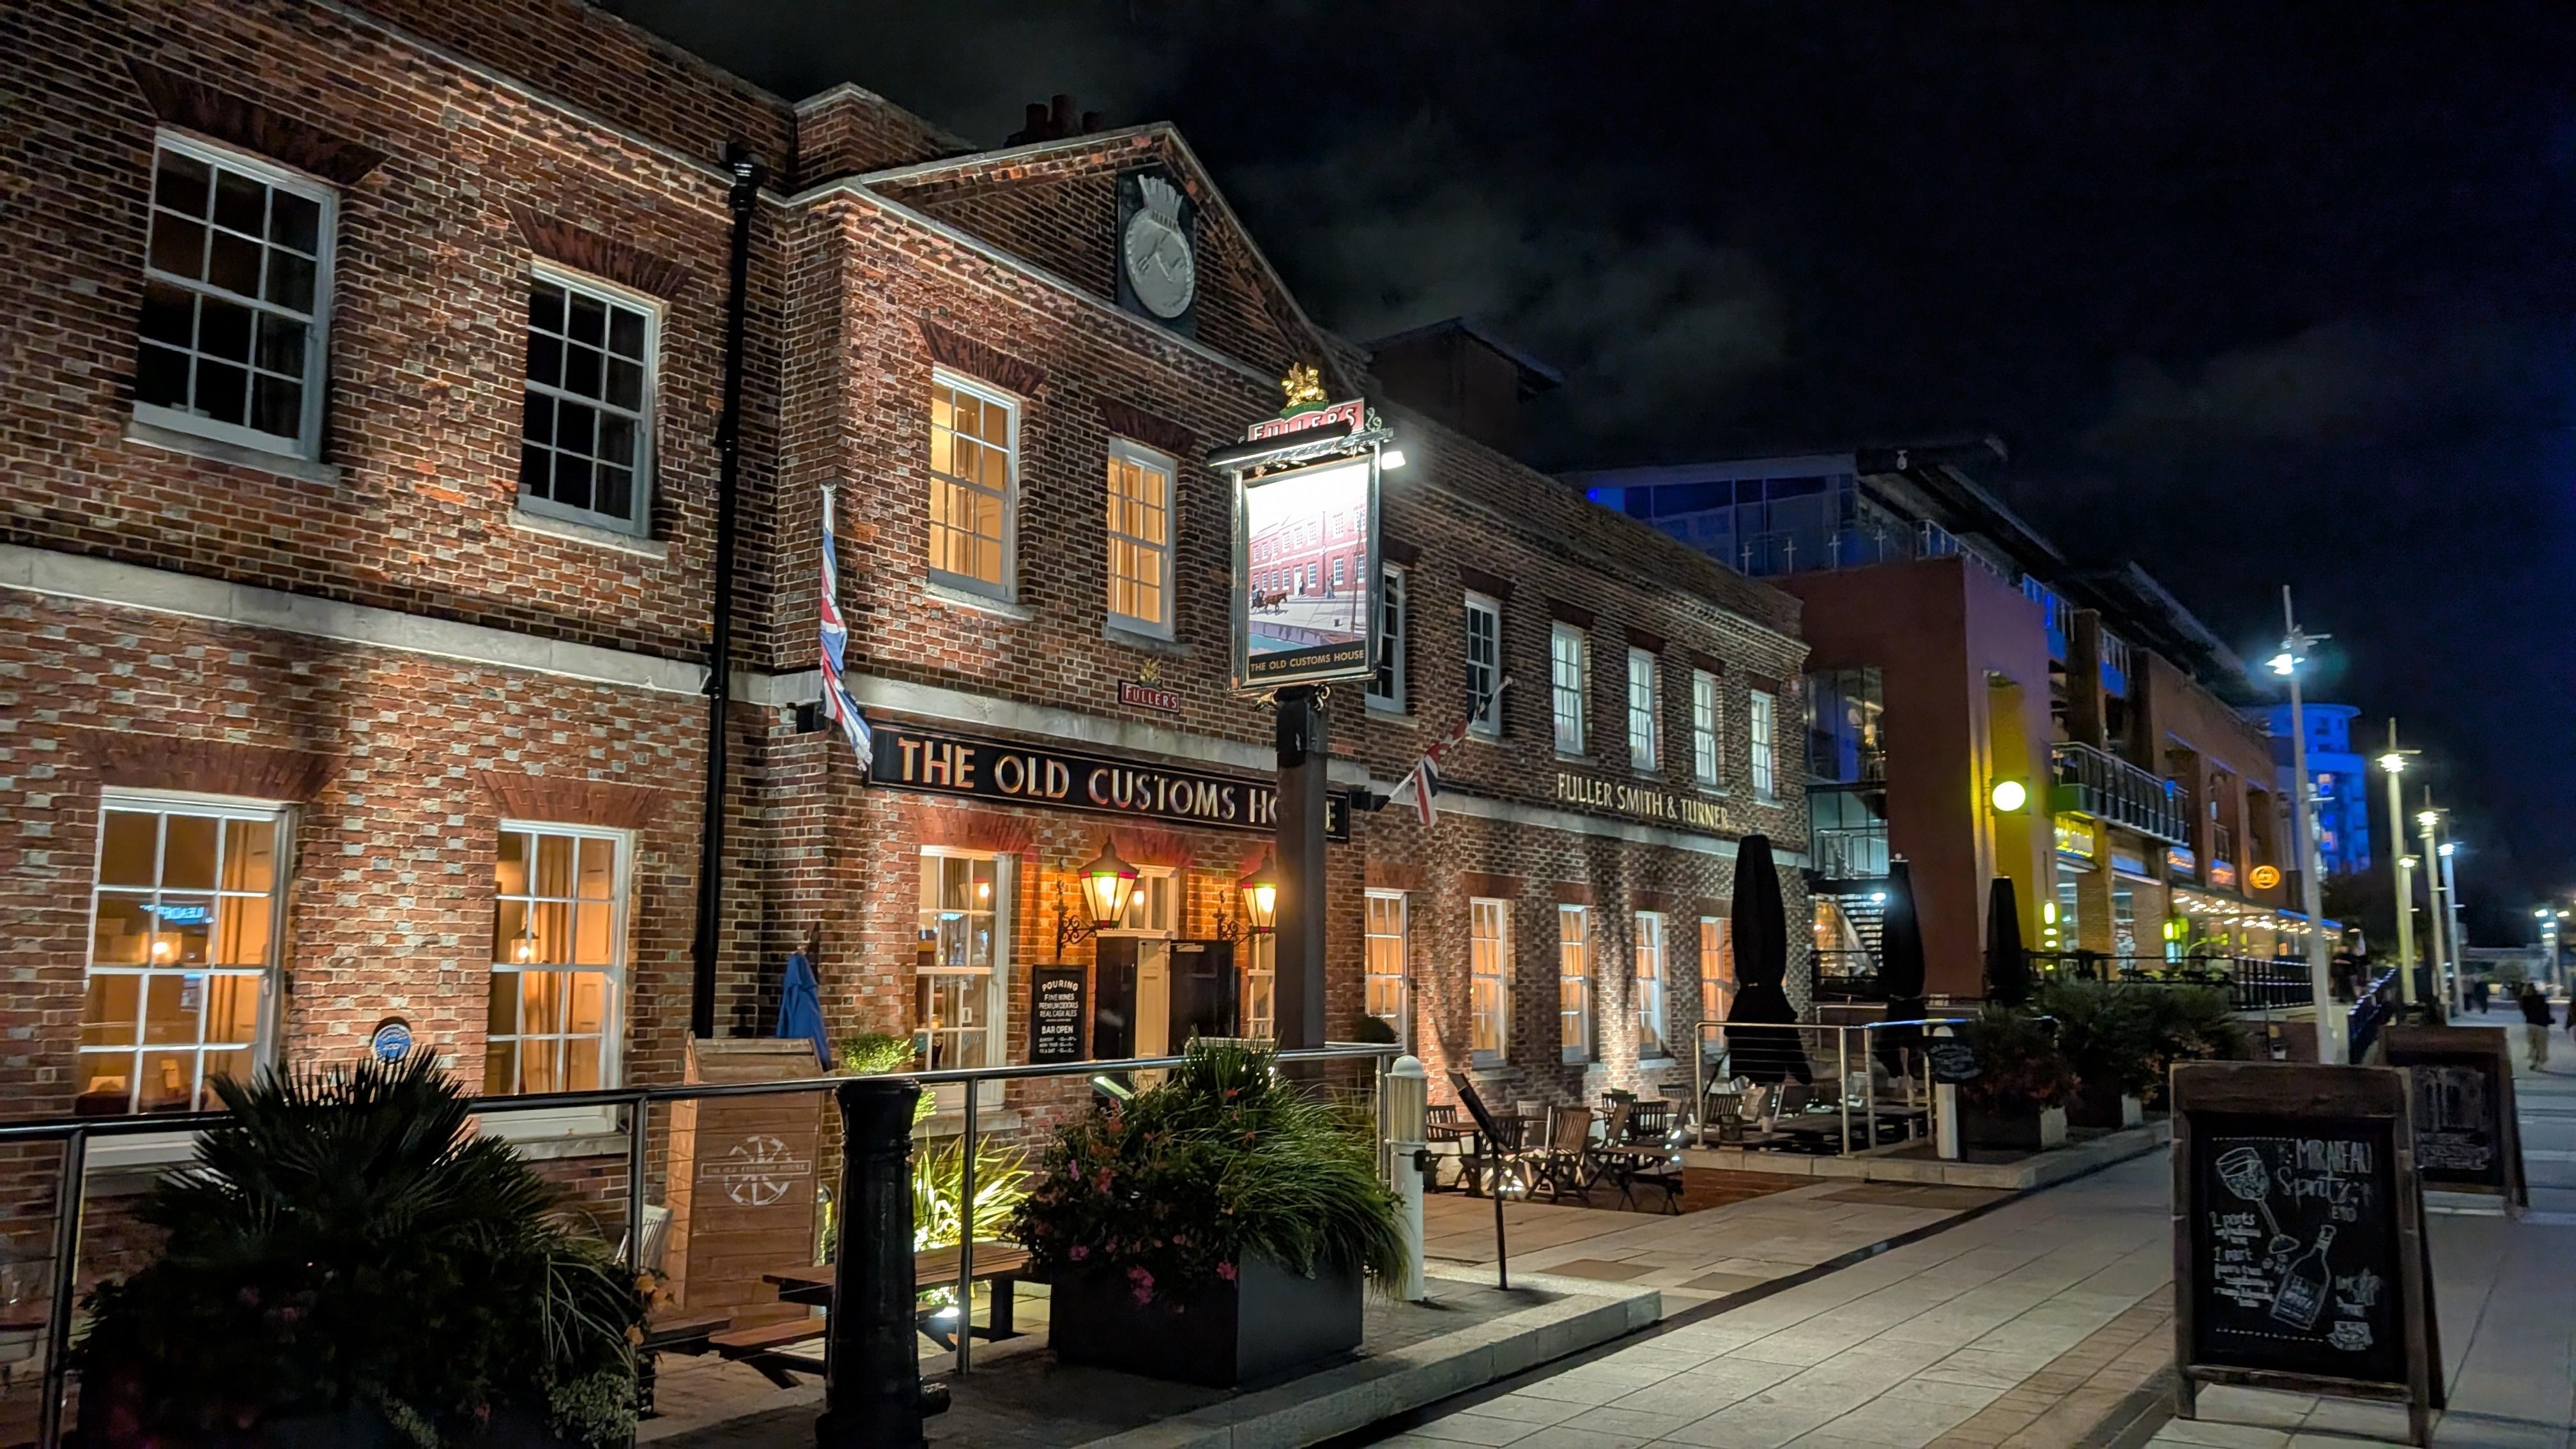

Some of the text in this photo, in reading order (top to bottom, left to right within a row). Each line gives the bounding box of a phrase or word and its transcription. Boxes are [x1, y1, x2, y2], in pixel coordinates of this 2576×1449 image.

[1250, 650, 1365, 671] THE OLD CUSTOMS HOUSE
[1125, 685, 1177, 709] FULLER'S
[898, 736, 975, 789] THE
[994, 755, 1070, 799] OLD
[1089, 768, 1236, 820] CUSTOMS
[1557, 772, 1729, 829] FULLER SMITH & TURNER
[1041, 979, 1079, 992] POURING
[1041, 1025, 1074, 1034] BAR OPEN
